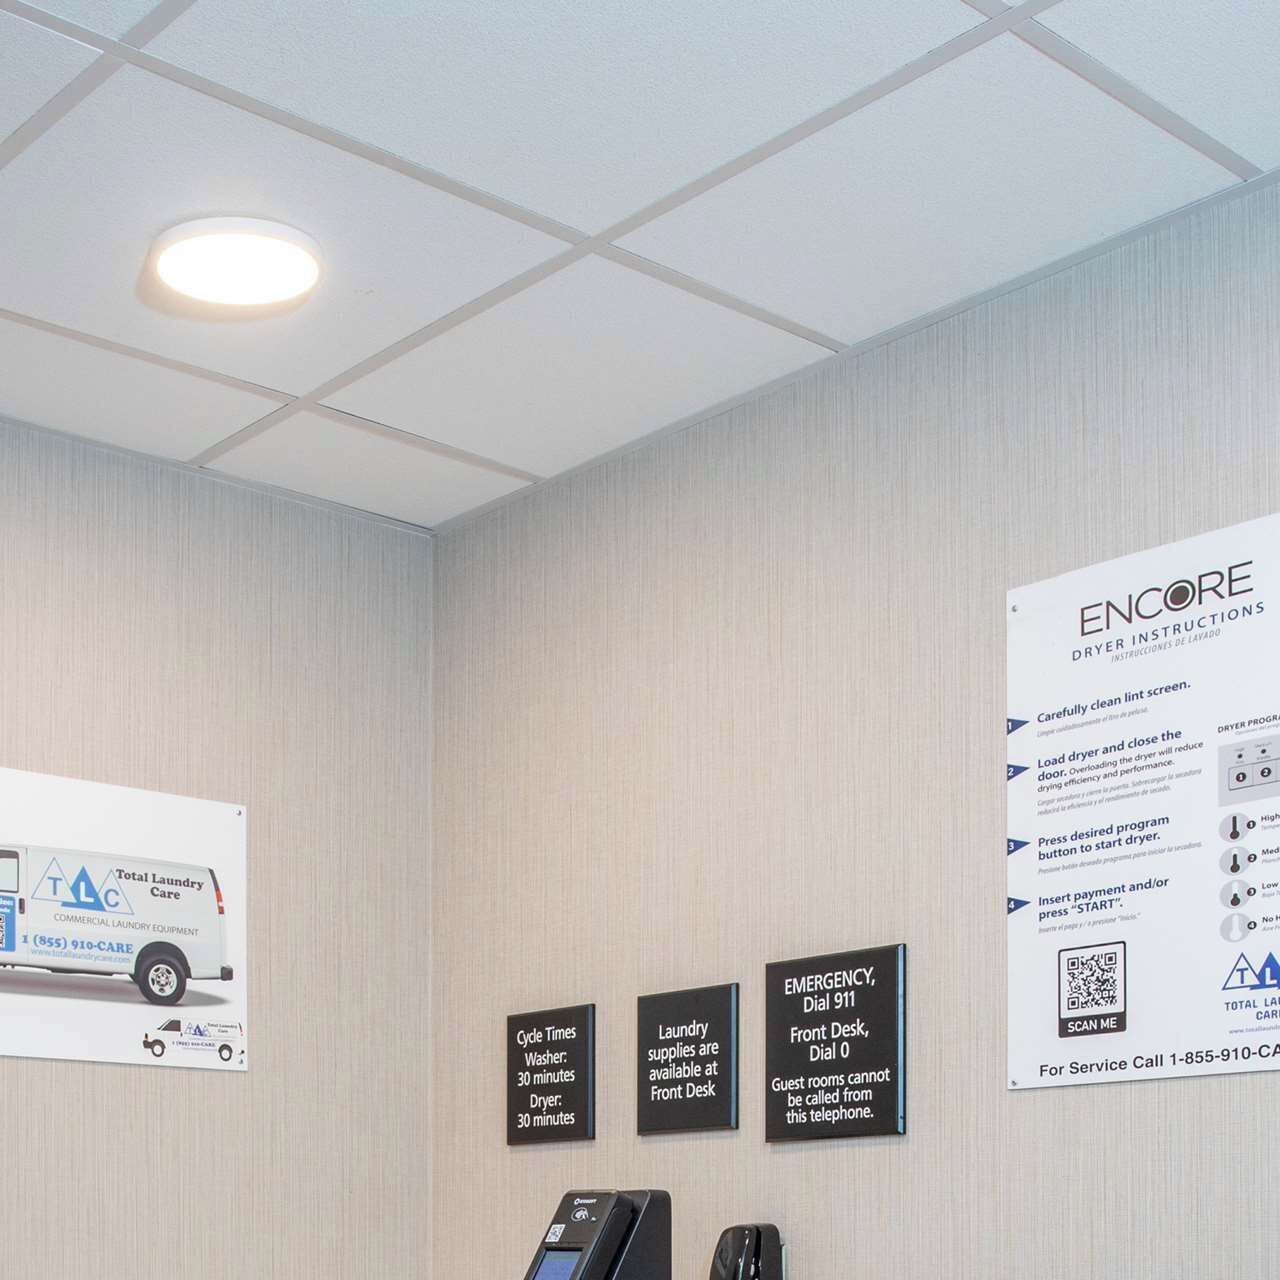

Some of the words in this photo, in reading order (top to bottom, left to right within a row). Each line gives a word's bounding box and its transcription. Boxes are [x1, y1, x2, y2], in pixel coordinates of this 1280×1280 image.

[1081, 559, 1253, 636] ENCORE
[1072, 638, 1124, 661] DRYER
[1132, 601, 1264, 645] INSTRUCTIONS
[1037, 703, 1088, 722] Carefully
[1090, 696, 1121, 710] clean
[1125, 689, 1144, 702] lint
[1147, 681, 1190, 697] screen.
[1217, 720, 1245, 733] DRYER
[1038, 752, 1065, 768] Load
[1068, 748, 1099, 761] dryer
[1102, 739, 1124, 754] and
[1128, 735, 1158, 748] close
[1161, 729, 1182, 741] the
[1261, 812, 1280, 822] High
[1038, 834, 1067, 847] Press
[1070, 823, 1113, 841] desired
[1117, 816, 1169, 835] program
[1038, 847, 1077, 860] button
[1080, 844, 1092, 852] to
[1095, 837, 1122, 850] start
[1125, 832, 1160, 845] dryer.
[116, 868, 148, 882] Total
[152, 873, 204, 891] Laundry
[47, 876, 119, 908] TLC
[150, 886, 180, 899] Care
[1039, 892, 1071, 905] Insert
[1074, 884, 1125, 902] payment
[1129, 877, 1169, 891] and/or
[54, 912, 110, 927] COMMERCIAL
[112, 919, 151, 930] LAUNDRY
[152, 923, 199, 936] EQUIPMENT
[1039, 907, 1068, 921] press
[22, 934, 28, 943] 1
[33, 934, 67, 949] (855)
[71, 939, 133, 954] 910-CARE
[785, 966, 875, 994] EMERGENCY,
[804, 992, 829, 1012] Dial
[834, 990, 854, 1008] 911
[1224, 999, 1258, 1010] TOTAL
[659, 1019, 708, 1039] Laundry
[791, 1024, 827, 1042] Front
[831, 1017, 869, 1038] Desk,
[1068, 1018, 1097, 1032] SCAN
[1100, 1016, 1117, 1029] ME
[517, 1027, 542, 1048] Cycle
[545, 1025, 576, 1040] Times
[525, 1049, 567, 1066] Washer:
[648, 1041, 695, 1063] supplies
[699, 1041, 719, 1055] are
[810, 1041, 835, 1061] Dial
[840, 1041, 849, 1057] 0
[649, 1060, 701, 1080] available
[705, 1060, 718, 1075] at
[1040, 1064, 1064, 1076] For
[1069, 1058, 1127, 1074] Service
[1133, 1053, 1163, 1068] Call
[517, 1071, 530, 1086] 30
[533, 1068, 575, 1084] minutes
[772, 1075, 805, 1091] Guest
[808, 1074, 845, 1088] rooms
[848, 1067, 890, 1084] cannot
[651, 1084, 683, 1100] Front
[686, 1079, 715, 1097] Desk
[788, 1092, 802, 1106] be
[805, 1087, 839, 1105] called
[842, 1086, 872, 1101] from
[530, 1093, 561, 1111] Dryer:
[517, 1112, 530, 1128] 30
[533, 1111, 575, 1126] minutes
[786, 1108, 807, 1123] this
[809, 1104, 873, 1123] telephone.
